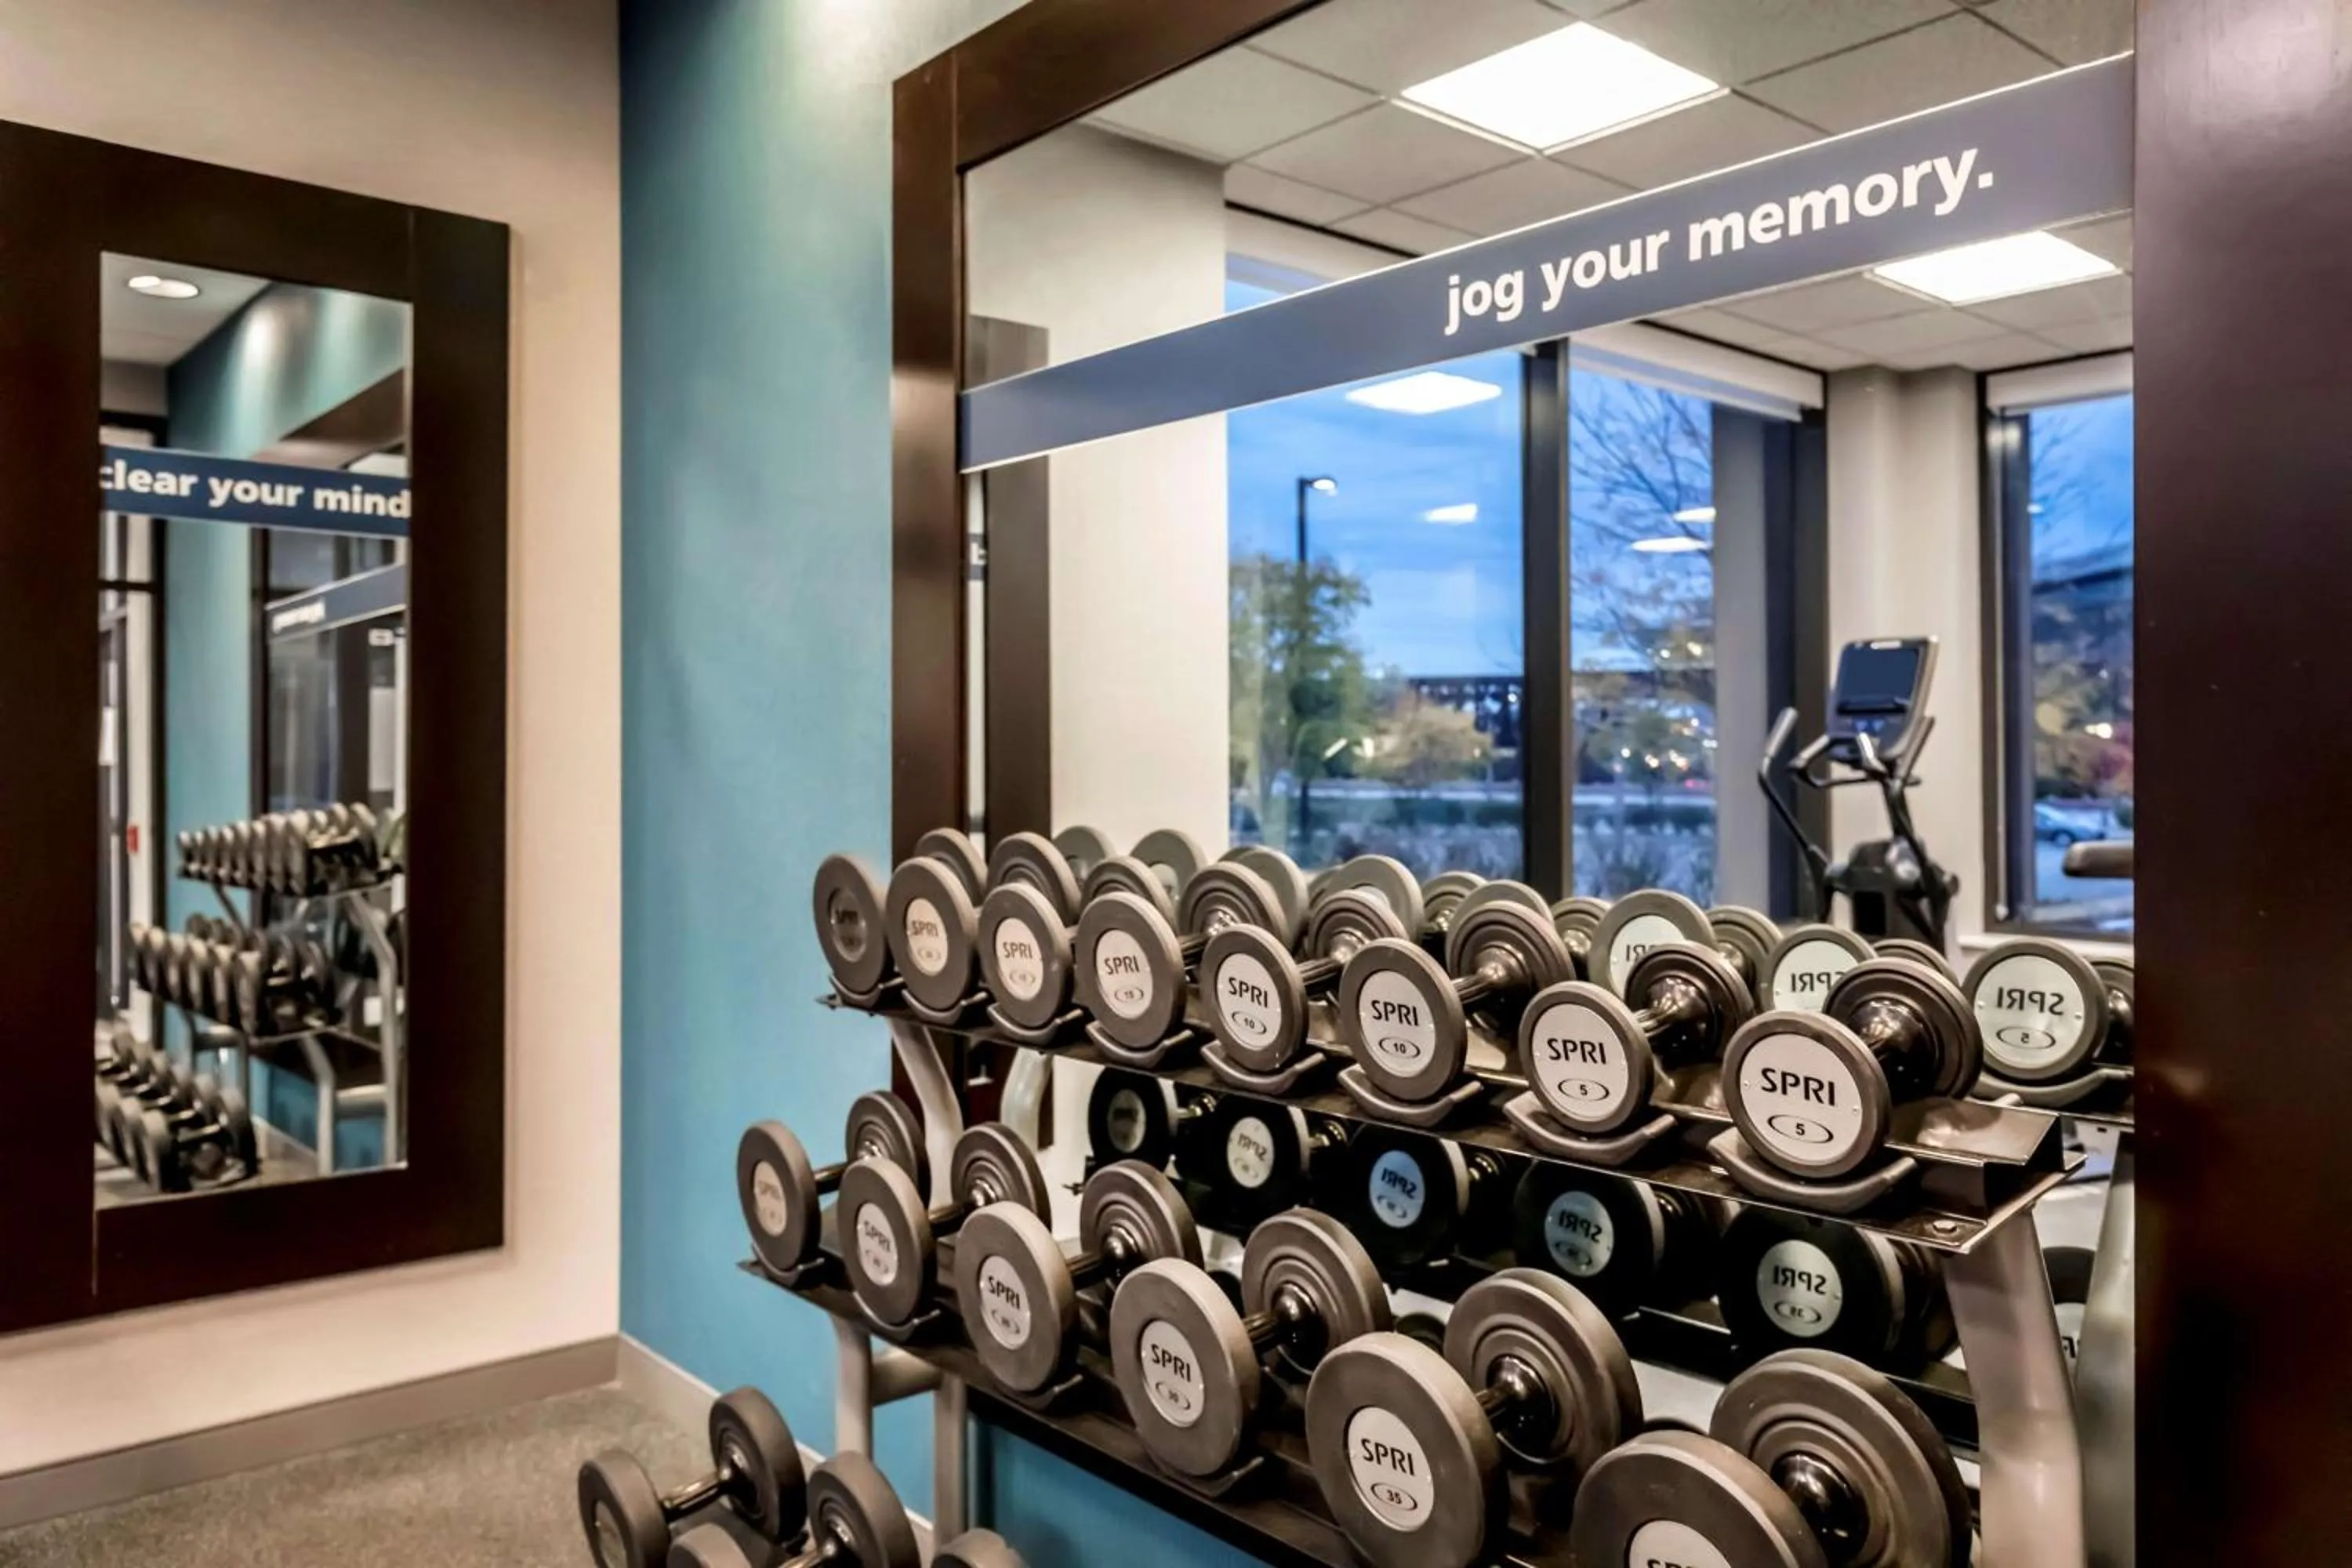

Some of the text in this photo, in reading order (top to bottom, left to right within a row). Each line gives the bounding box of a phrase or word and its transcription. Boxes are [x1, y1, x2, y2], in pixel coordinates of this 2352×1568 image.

[1444, 147, 1994, 335] jog your memory.
[208, 476, 305, 509] your
[313, 485, 412, 518] mind
[1003, 942, 1033, 959] SPRI
[1104, 955, 1141, 975] SPRI
[1228, 977, 1269, 1008] SPRI
[1370, 1000, 1420, 1027] SPRI
[1393, 1042, 1406, 1054] 10
[1547, 1037, 1607, 1065] SPRI
[1579, 1084, 1588, 1096] 5
[1761, 1067, 1836, 1107] SPRI
[1795, 1123, 1806, 1136] 5
[987, 1276, 1021, 1309] SPRI
[1150, 1343, 1192, 1382] SPRI
[1360, 1437, 1416, 1476] SPRI
[1386, 1489, 1403, 1505] 35
